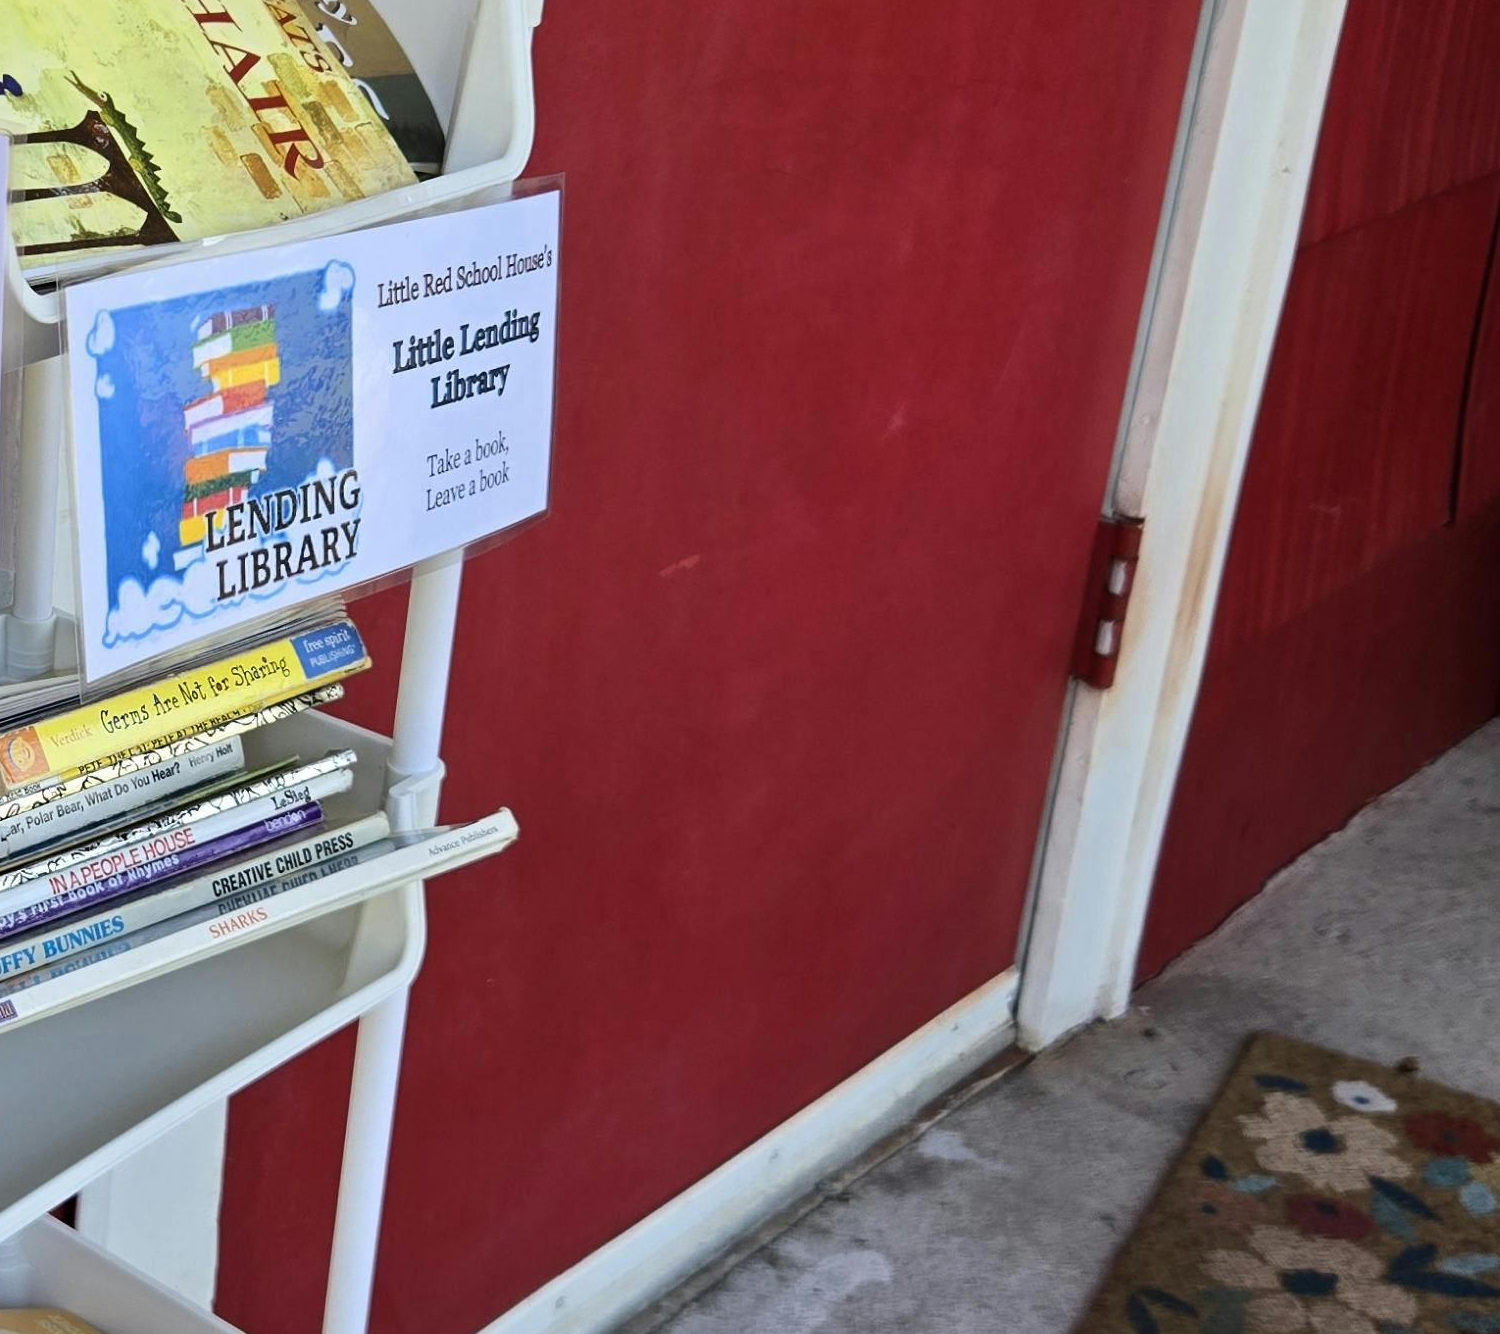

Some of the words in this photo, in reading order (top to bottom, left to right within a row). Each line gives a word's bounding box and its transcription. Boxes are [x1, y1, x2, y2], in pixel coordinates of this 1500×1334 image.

[377, 278, 419, 308] Little
[422, 271, 453, 298] Red
[456, 256, 503, 289] School
[505, 243, 553, 278] House's
[392, 329, 455, 374] Little
[460, 309, 540, 347] Lending
[430, 364, 510, 409] Library
[426, 449, 461, 477] Take
[463, 447, 472, 465] a
[474, 431, 509, 460] book,
[426, 482, 465, 511] Leave
[468, 480, 476, 495] a
[479, 462, 510, 491] book
[204, 468, 362, 553] LENDING
[216, 518, 362, 602] LIBRARY
[303, 638, 324, 653] free
[324, 629, 351, 648] spirit
[309, 644, 355, 667] PUBLISHING
[50, 724, 93, 748] Verdick
[100, 707, 149, 735] Germs
[153, 693, 180, 716] Are
[180, 680, 207, 708] Not
[209, 674, 230, 697] for
[234, 655, 291, 690] Sharing
[25, 809, 54, 830] Polar
[55, 798, 84, 820] Bear,
[84, 784, 113, 808] What
[115, 779, 130, 795] Do
[130, 774, 151, 792] You
[151, 762, 181, 786] Hear?
[188, 749, 216, 769] Henry
[215, 741, 234, 759] Holt
[270, 785, 312, 810] LeSieg
[49, 875, 68, 895] IN
[68, 869, 81, 888] A
[82, 850, 141, 882] PEOPLE
[143, 827, 196, 860] HOUSE
[108, 872, 124, 888] of
[127, 853, 180, 884] Rhymes
[263, 808, 307, 834] bendon
[42, 915, 125, 959] BUNNIES
[212, 861, 275, 898] CREATIVE
[277, 847, 313, 876] CHILD
[315, 832, 354, 859] PRESS
[209, 907, 269, 940] SHARKS
